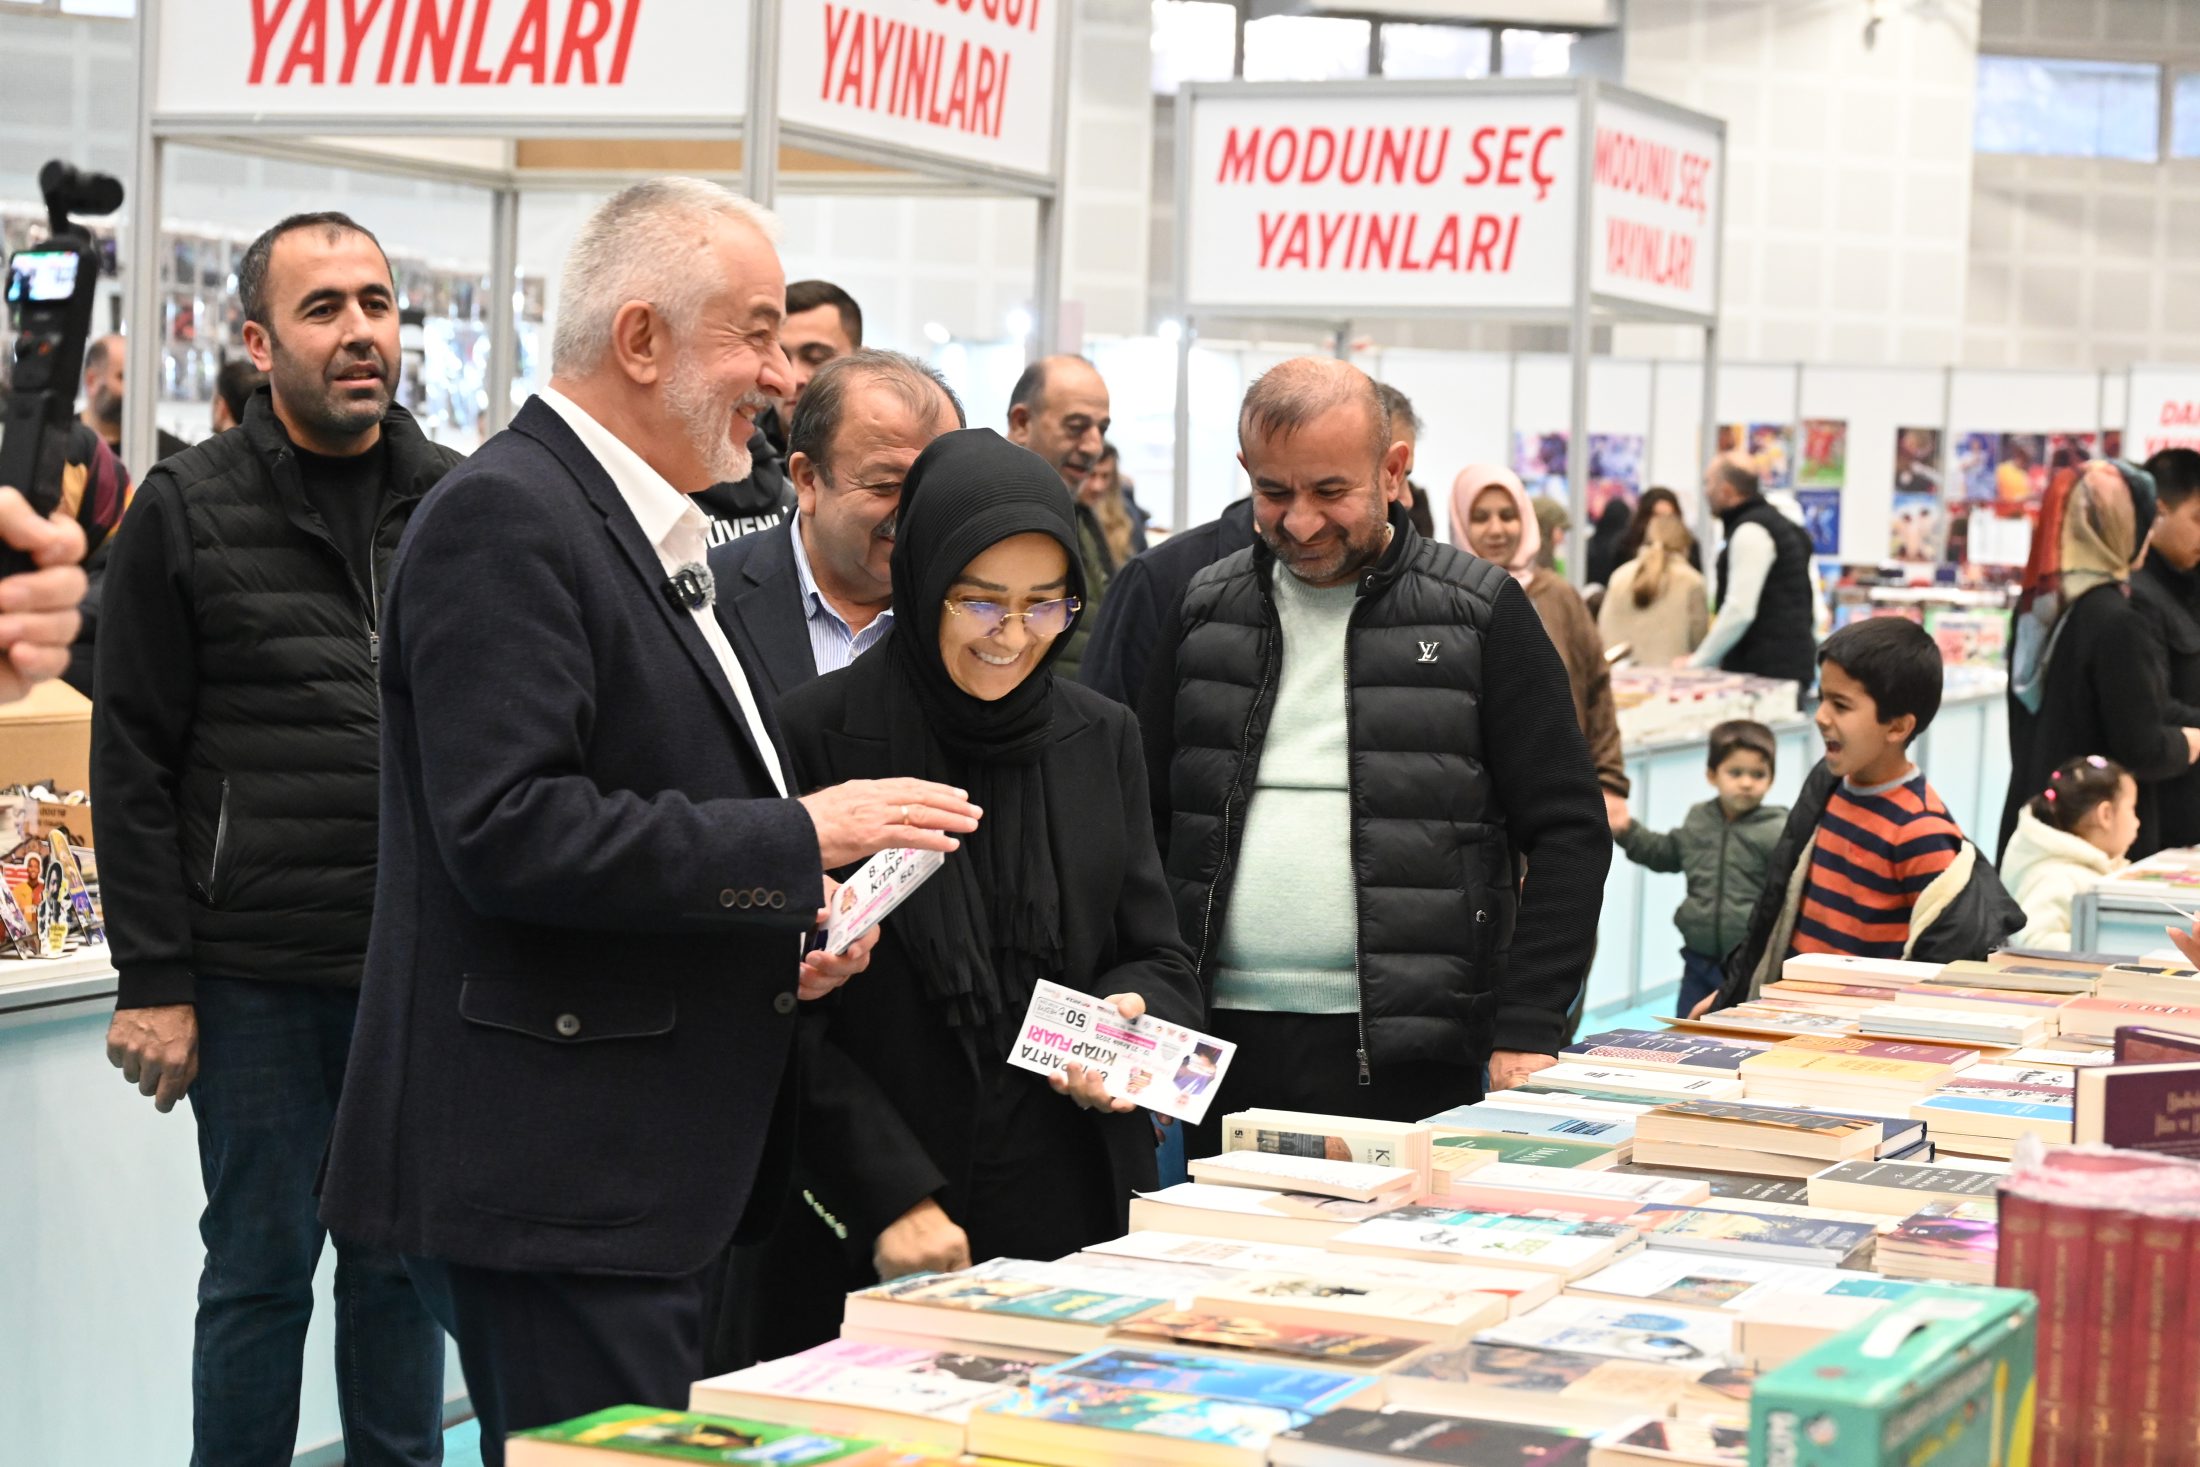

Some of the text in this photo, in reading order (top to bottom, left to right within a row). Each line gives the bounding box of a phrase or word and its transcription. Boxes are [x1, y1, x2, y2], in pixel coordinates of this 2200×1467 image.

[247, 0, 643, 86] YAYINLARI
[821, 3, 1011, 138] YAYINLARI
[1217, 126, 1565, 202] MODUNU SEÇ
[1592, 126, 1677, 204] MODUNU
[1257, 211, 1521, 274] YAYINLARI
[1606, 215, 1697, 291] YAYINLARI
[1026, 1024, 1073, 1053] FUARI
[1065, 1009, 1087, 1028] 50
